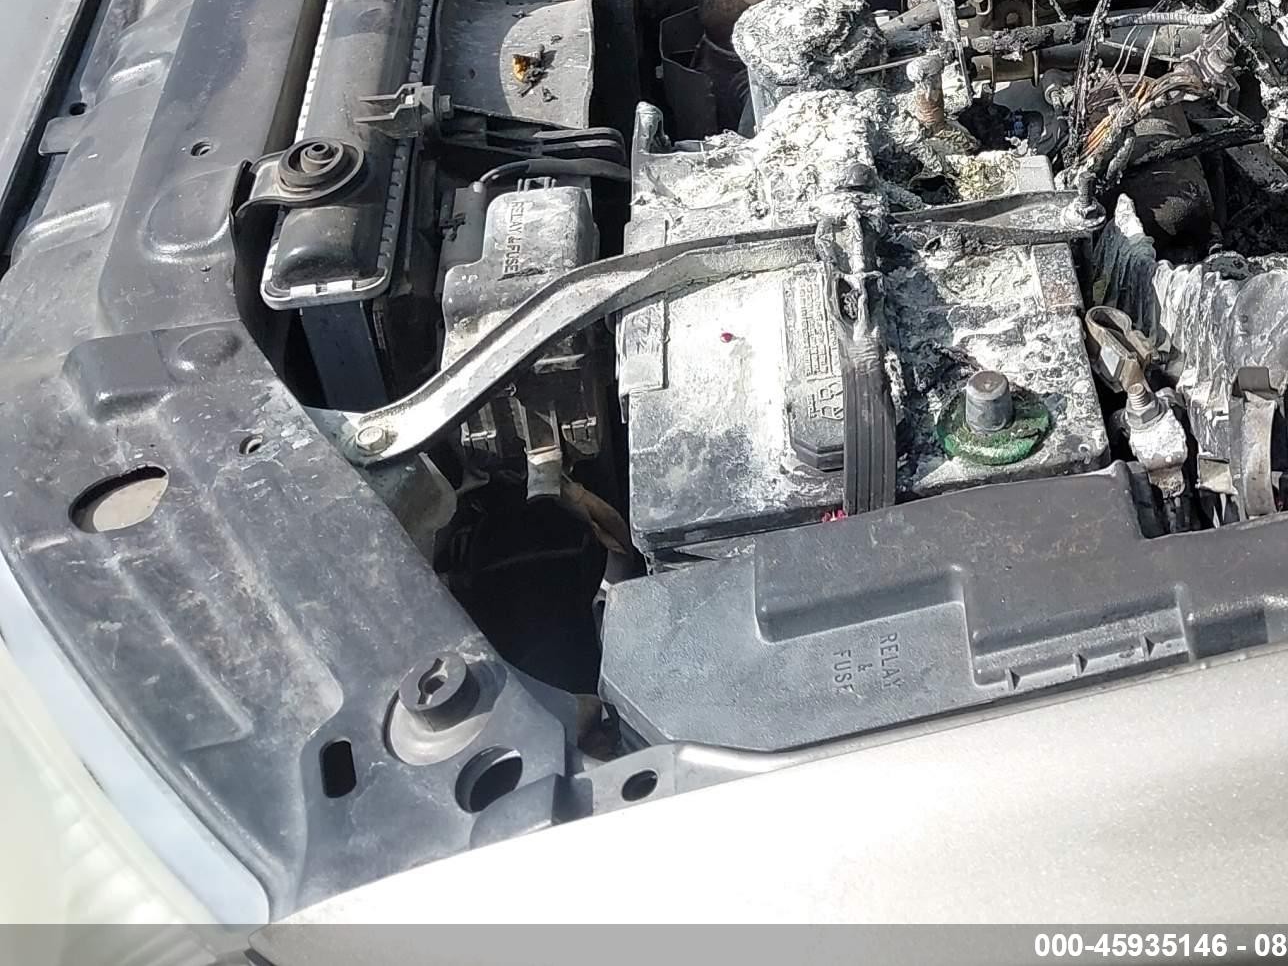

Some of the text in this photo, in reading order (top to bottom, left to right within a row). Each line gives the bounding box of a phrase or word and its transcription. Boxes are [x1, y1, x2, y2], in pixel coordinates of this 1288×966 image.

[509, 202, 524, 233] RELAY
[504, 245, 520, 273] FUSE
[832, 649, 855, 695] FUSE
[857, 663, 873, 673] &
[879, 632, 905, 688] RELAY
